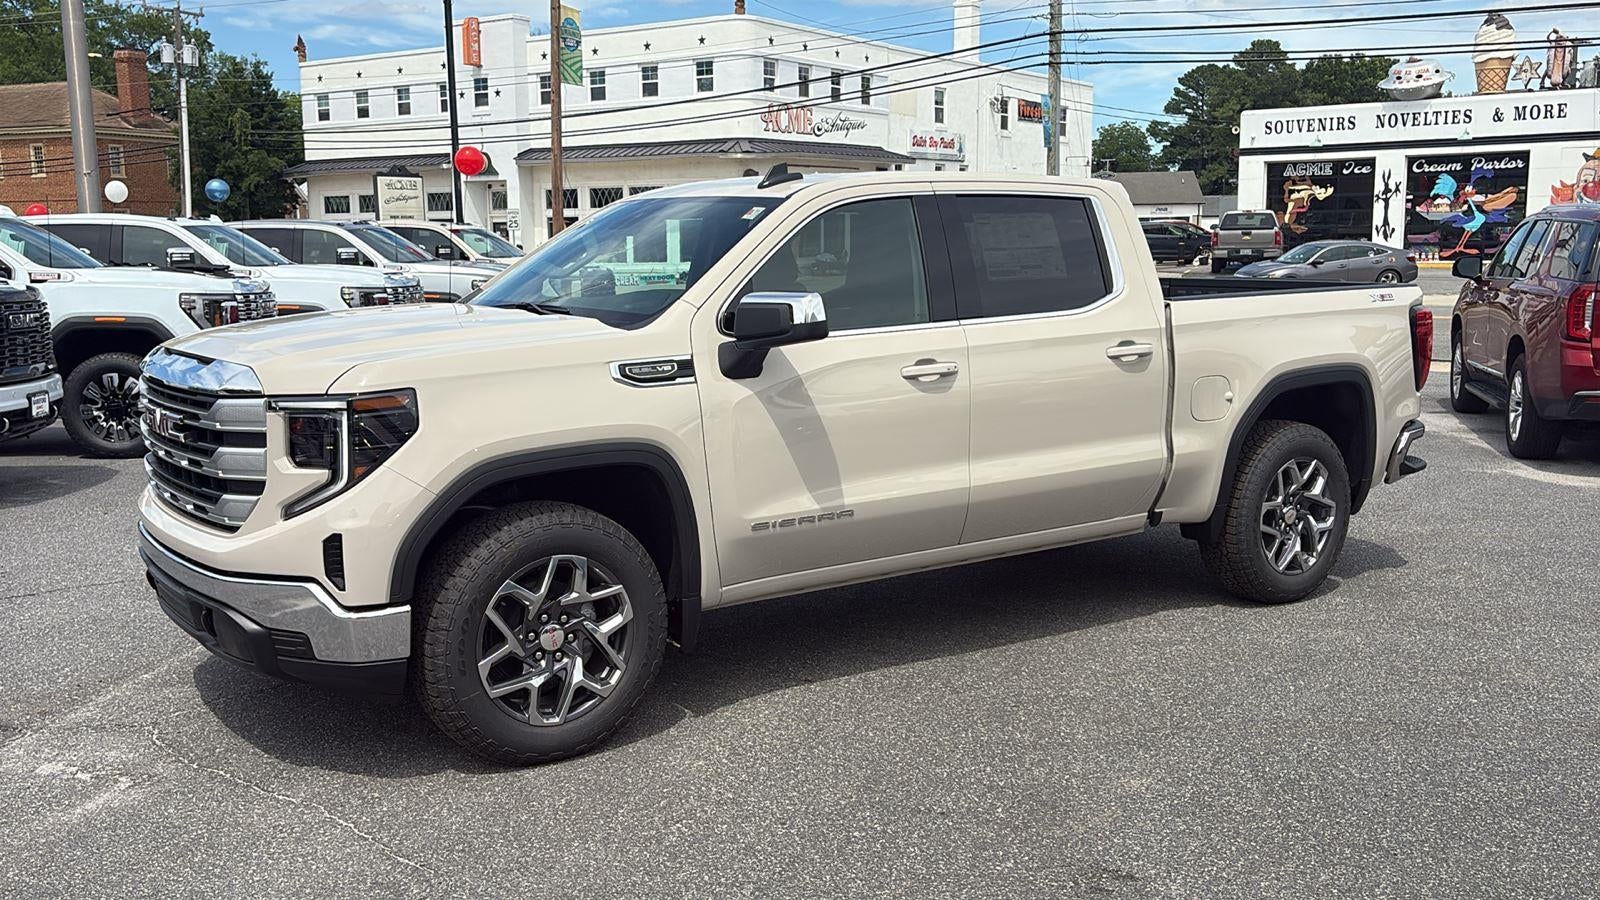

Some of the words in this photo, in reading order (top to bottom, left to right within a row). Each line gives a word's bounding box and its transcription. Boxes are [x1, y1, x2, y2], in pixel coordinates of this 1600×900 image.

[760, 103, 813, 135] ACME
[813, 112, 868, 138] Antiques
[1264, 115, 1356, 135] SOUVENIRS
[1375, 108, 1473, 129] NOVELTIES
[1492, 107, 1504, 123] &
[1513, 103, 1568, 121] MORE
[929, 136, 938, 151] Boy
[1283, 162, 1333, 177] ACME
[1342, 161, 1373, 175] Ice
[1412, 159, 1463, 173] Cream
[1470, 157, 1525, 171] Parlor
[385, 180, 418, 190] ACME
[509, 220, 519, 229] 25
[141, 407, 185, 443] GMC
[751, 509, 854, 532] SIERRA
